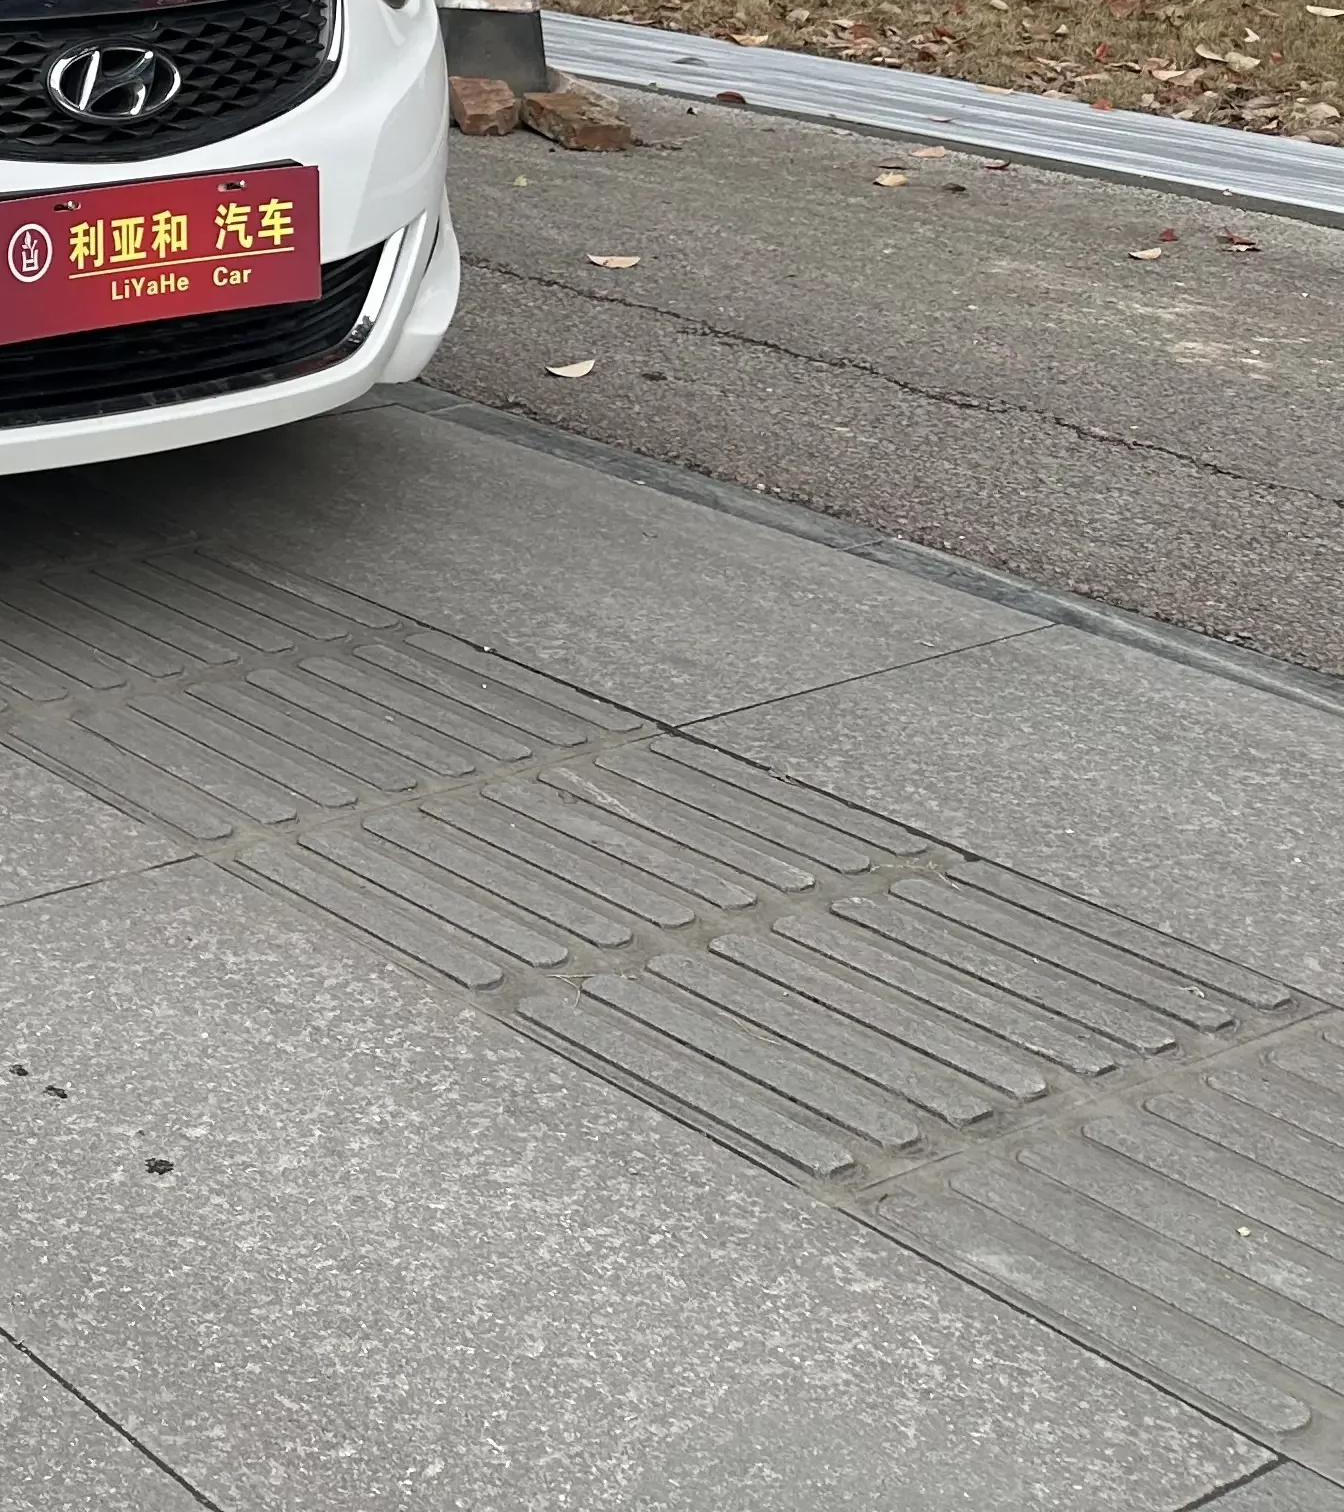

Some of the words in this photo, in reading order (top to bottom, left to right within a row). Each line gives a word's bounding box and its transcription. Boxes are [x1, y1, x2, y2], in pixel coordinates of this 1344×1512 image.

[69, 209, 189, 271] 利亚和
[214, 198, 295, 251] 汽车
[111, 273, 190, 302] LiYaHe
[212, 265, 252, 287] Car
